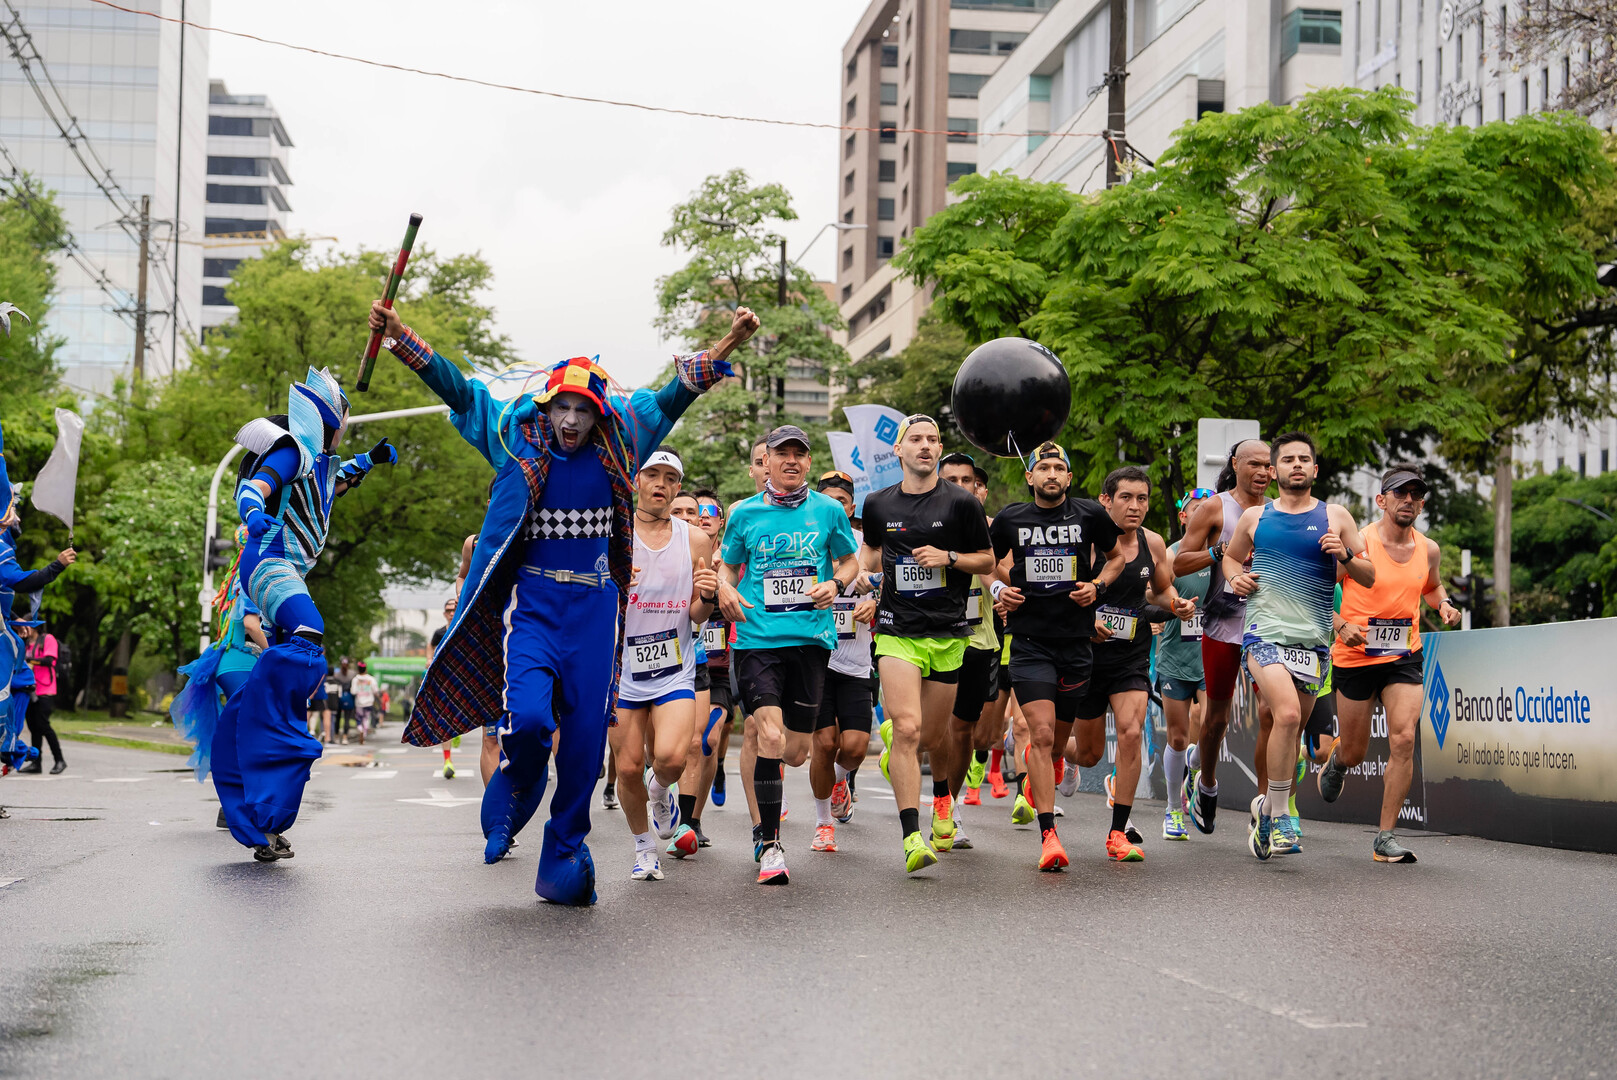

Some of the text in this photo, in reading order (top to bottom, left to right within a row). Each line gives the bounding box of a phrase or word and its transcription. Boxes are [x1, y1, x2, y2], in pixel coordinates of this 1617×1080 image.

[874, 451, 895, 463] Banc
[875, 459, 900, 474] Occid
[1018, 524, 1083, 547] PACER
[755, 531, 819, 562] 42K
[903, 566, 933, 582] 5669
[1034, 558, 1064, 573] 3606
[772, 578, 804, 596] 3642
[637, 601, 665, 610] gomar
[832, 612, 846, 626] 79
[1375, 627, 1401, 642] 1478
[635, 643, 669, 663] 5224
[1283, 649, 1311, 666] 5935
[1454, 686, 1591, 724] Banco de Occidente
[1457, 742, 1577, 774] Del lado de los que hacen.
[1362, 760, 1377, 781] que
